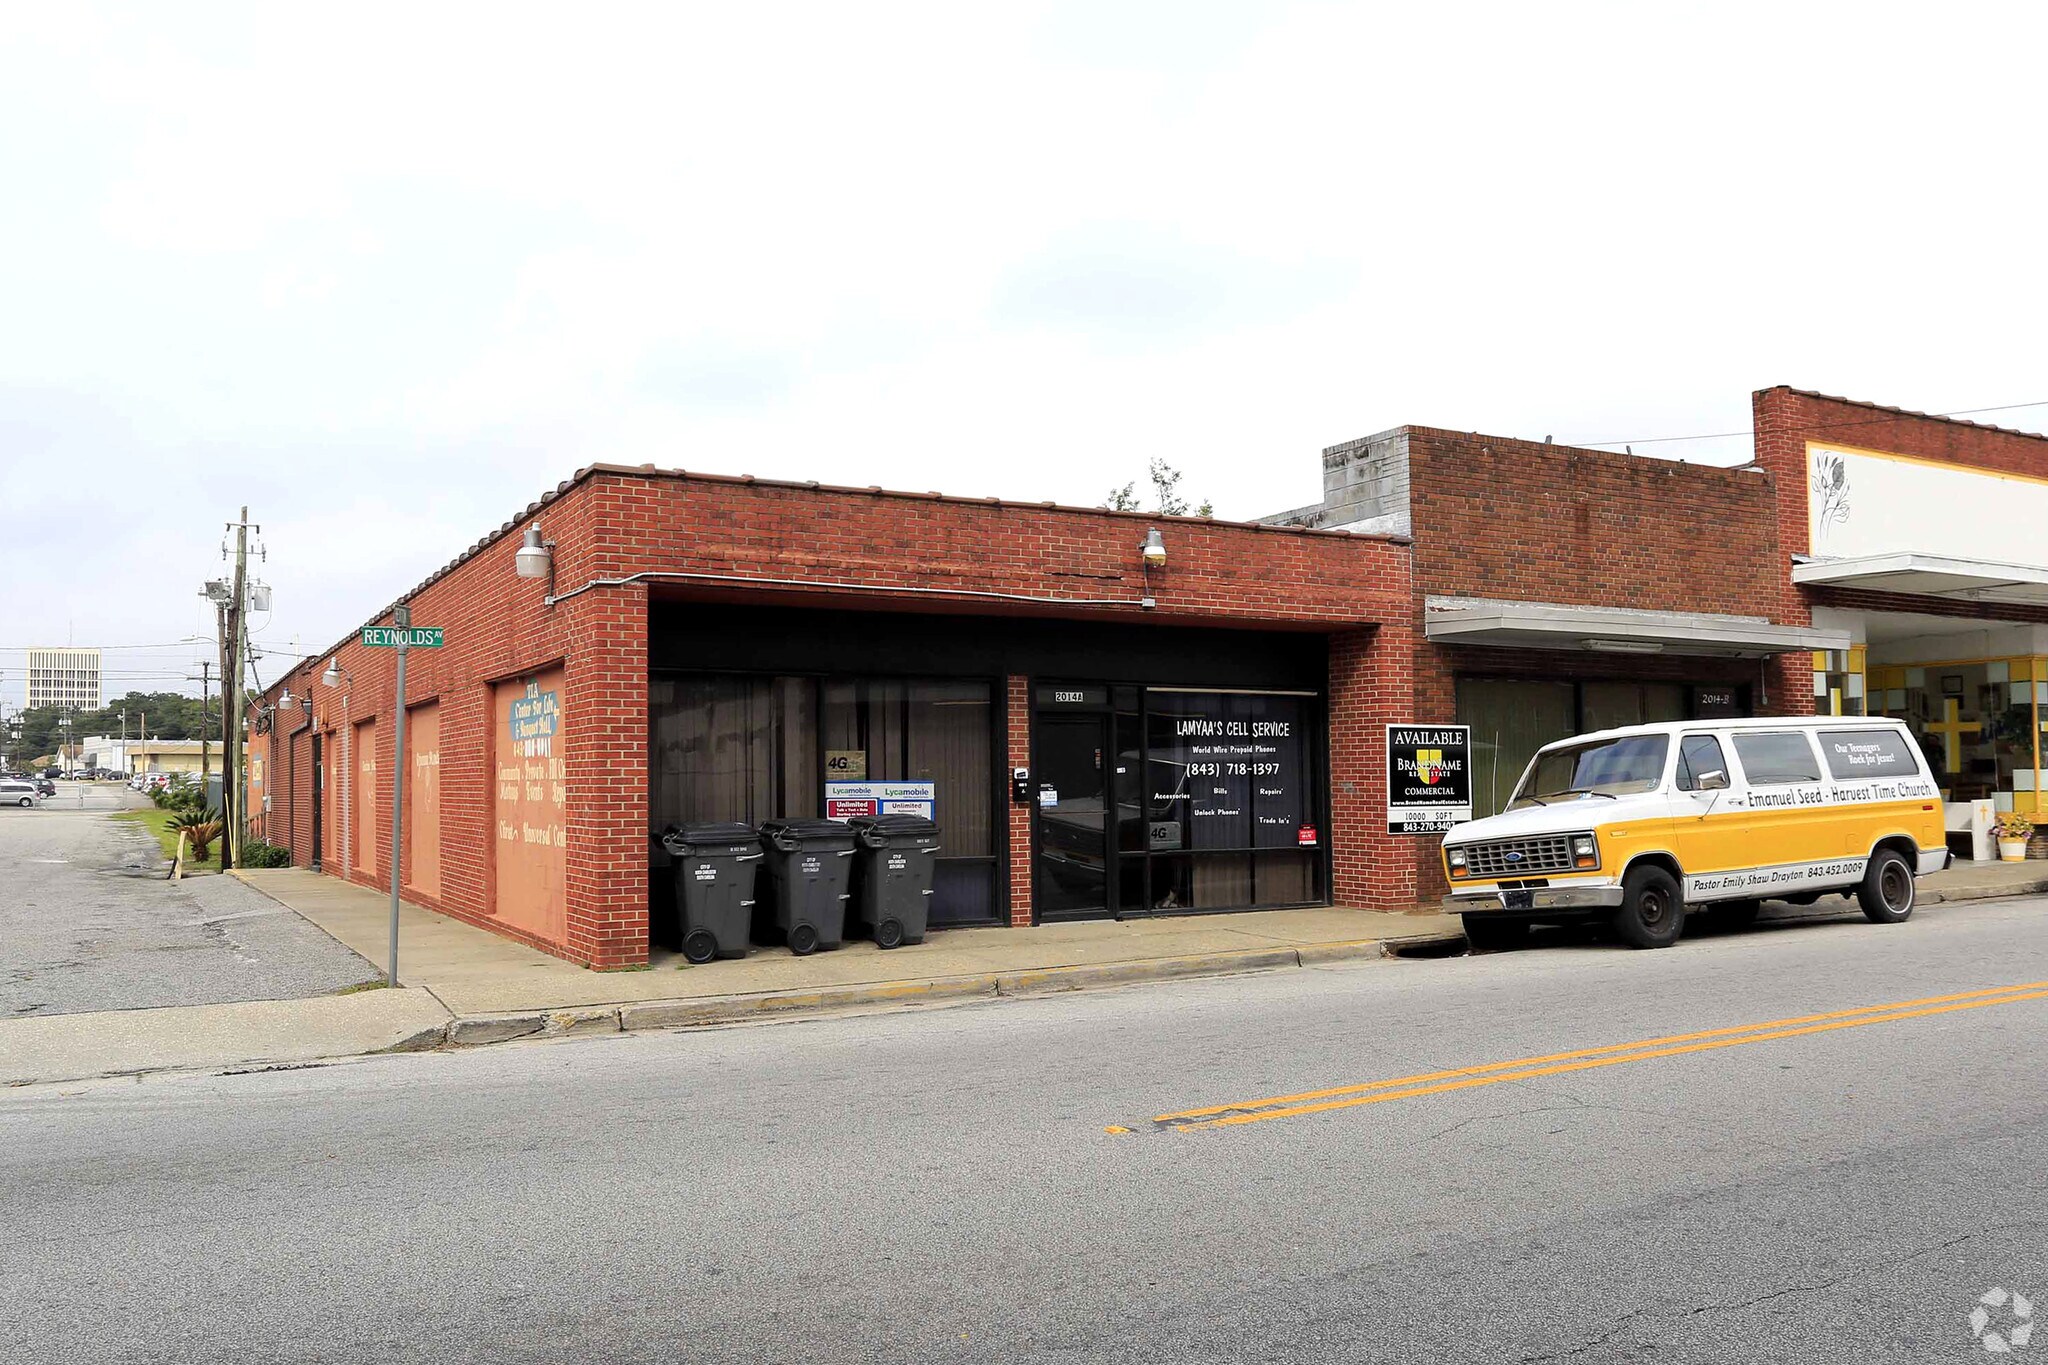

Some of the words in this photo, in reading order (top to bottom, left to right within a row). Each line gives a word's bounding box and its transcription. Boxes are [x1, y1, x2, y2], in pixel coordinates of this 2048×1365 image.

[364, 629, 434, 644] REYNOLDS
[1056, 692, 1083, 702] 2014A
[1177, 720, 1223, 737] LAMYAA'S
[1226, 721, 1249, 736] CELL
[1252, 721, 1290, 737] SERVICE
[1394, 731, 1463, 745] AVAILABLE
[1192, 745, 1211, 754] World
[1213, 745, 1228, 754] Wire
[1229, 745, 1253, 755] Prepaid
[1255, 745, 1277, 753] Phones
[1834, 743, 1848, 753] Our
[1848, 743, 1881, 754] Teenagers
[828, 757, 848, 769] 4G
[1848, 755, 1866, 765] Rock
[1865, 754, 1877, 766] for
[1876, 752, 1896, 766] Jesus!
[1186, 763, 1220, 778] (843)
[1226, 763, 1280, 775] 718-1397
[832, 787, 872, 795] Lycamobile
[885, 788, 929, 797] Lycamobile
[1405, 787, 1455, 796] COMMERCIAL
[1747, 788, 1796, 808] Emanuel
[1798, 786, 1823, 804] Seed
[1830, 781, 1871, 802] Harvest
[1871, 783, 1896, 799] Time
[1898, 781, 1932, 797] Church
[1405, 812, 1426, 821] 10000
[1151, 828, 1167, 839] 4G
[1694, 880, 1720, 891] Pastor
[1722, 875, 1746, 888] Emily
[1747, 874, 1770, 885] Shaw
[1771, 871, 1804, 883] Drayton
[1807, 862, 1863, 878] 843.452.0009
